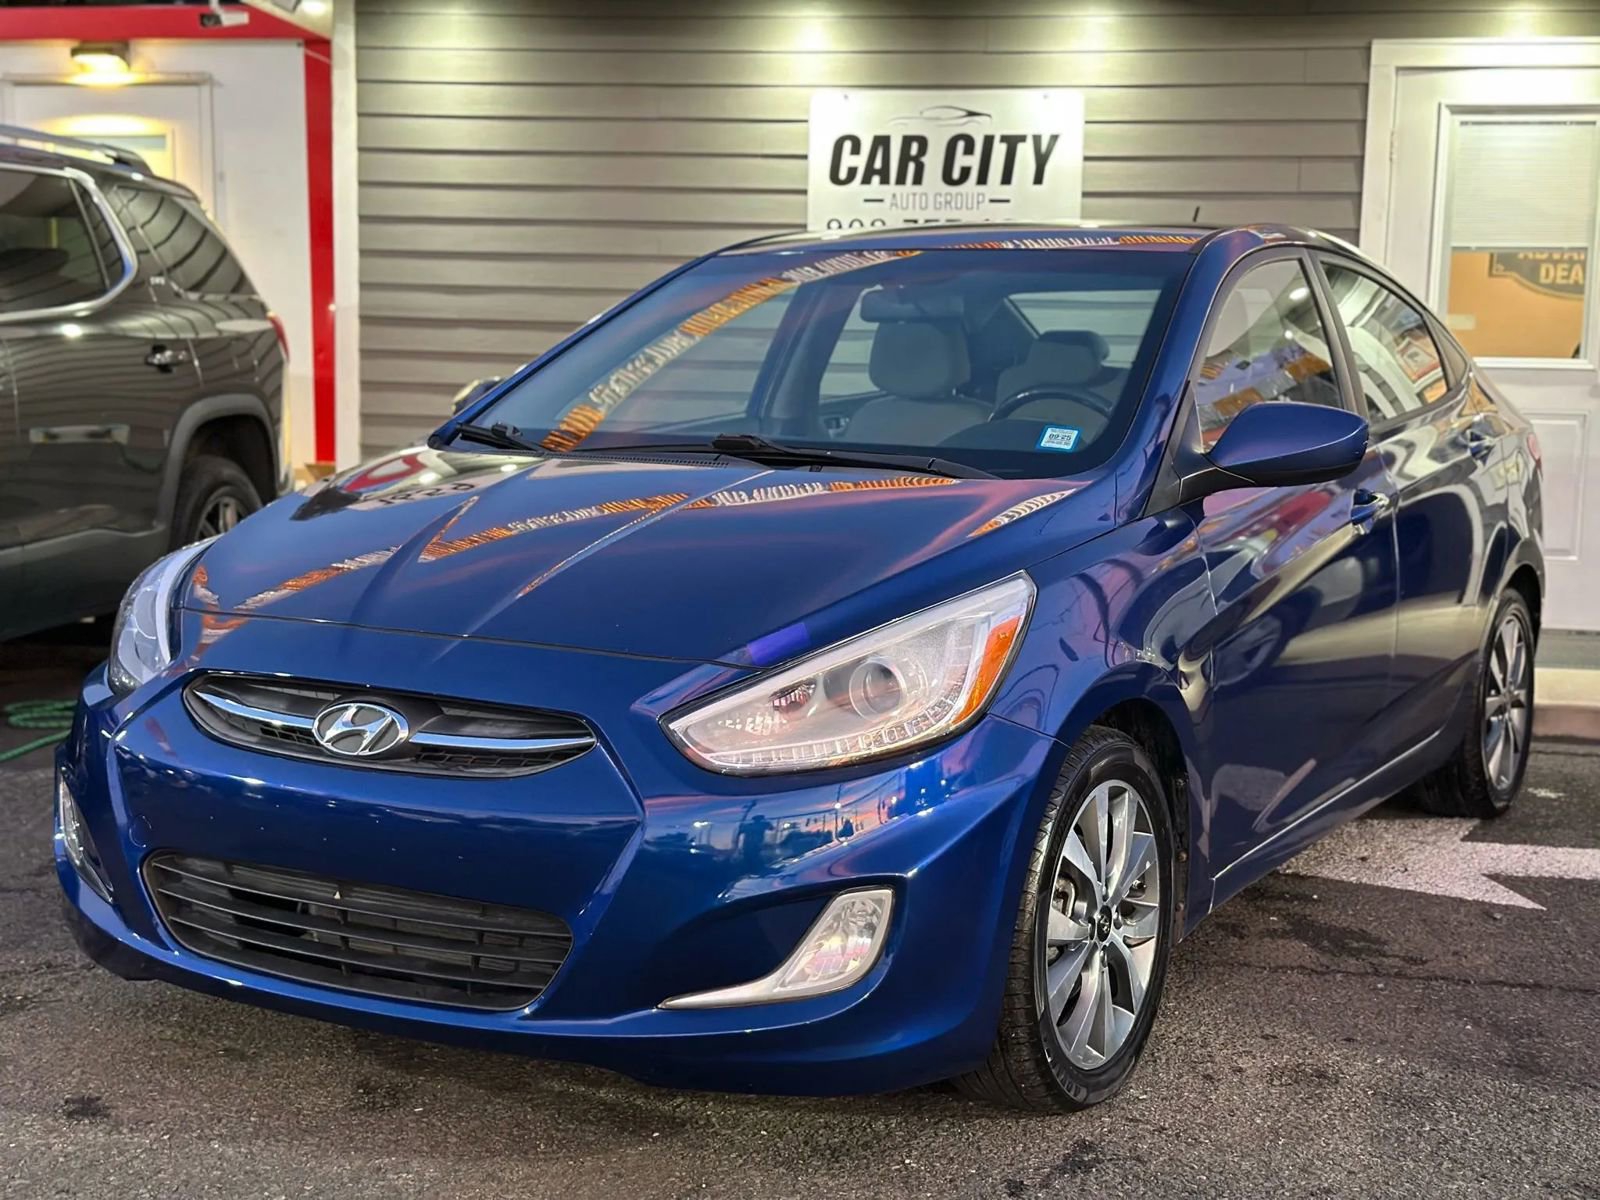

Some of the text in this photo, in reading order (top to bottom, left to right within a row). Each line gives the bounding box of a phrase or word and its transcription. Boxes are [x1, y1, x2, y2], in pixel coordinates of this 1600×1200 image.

[829, 133, 1060, 186] CAR CITY
[889, 193, 986, 211] AUTO GROUP
[1540, 263, 1584, 284] DEA
